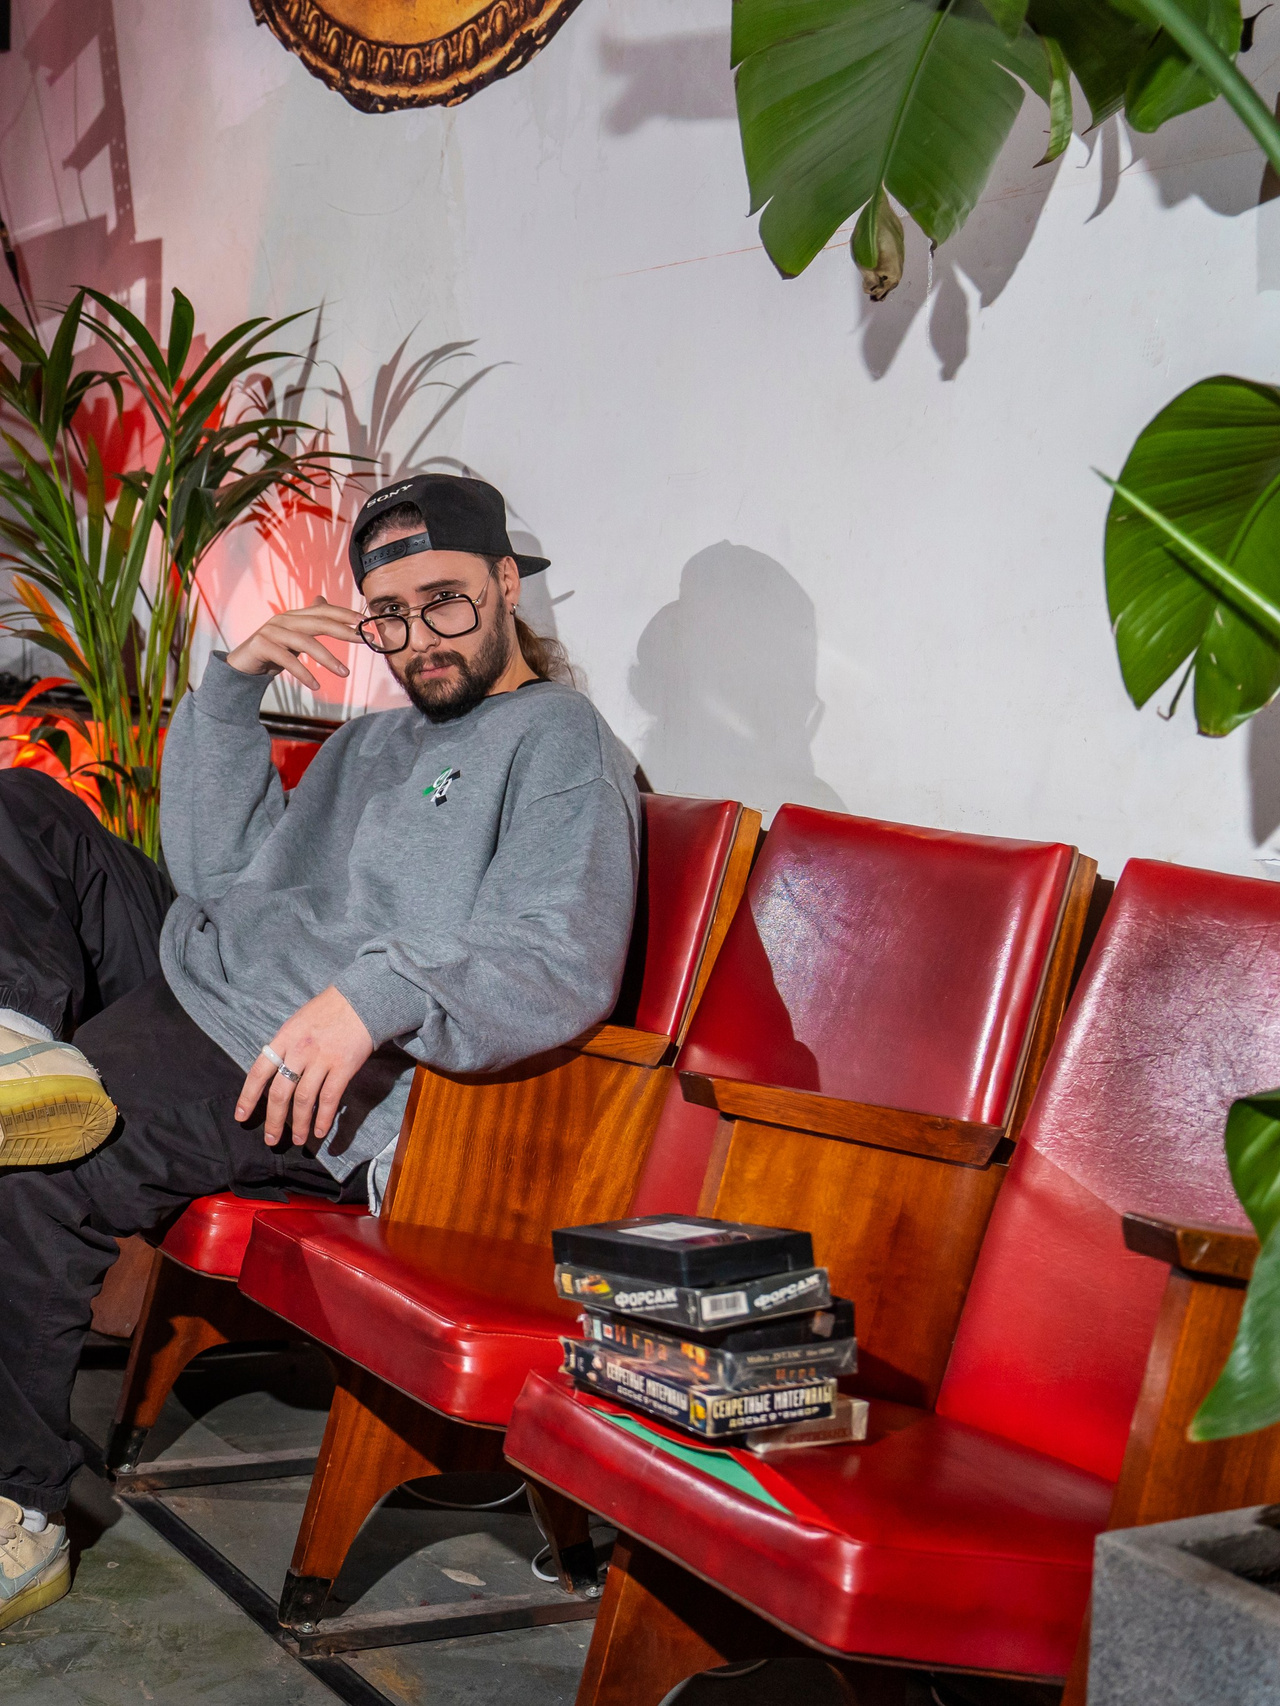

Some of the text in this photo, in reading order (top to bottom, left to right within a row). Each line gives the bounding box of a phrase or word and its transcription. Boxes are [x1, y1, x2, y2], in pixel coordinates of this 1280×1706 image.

[366, 483, 414, 509] SONY
[614, 1287, 678, 1309] ФОРСАЖ
[753, 1273, 821, 1308] ФОРСАЖ
[614, 1323, 668, 1361] Игра
[712, 1385, 833, 1420] СЕКРЕТНЫЕ МАТЕРИАЛЫ
[728, 1412, 769, 1429] ДОСЬЕ
